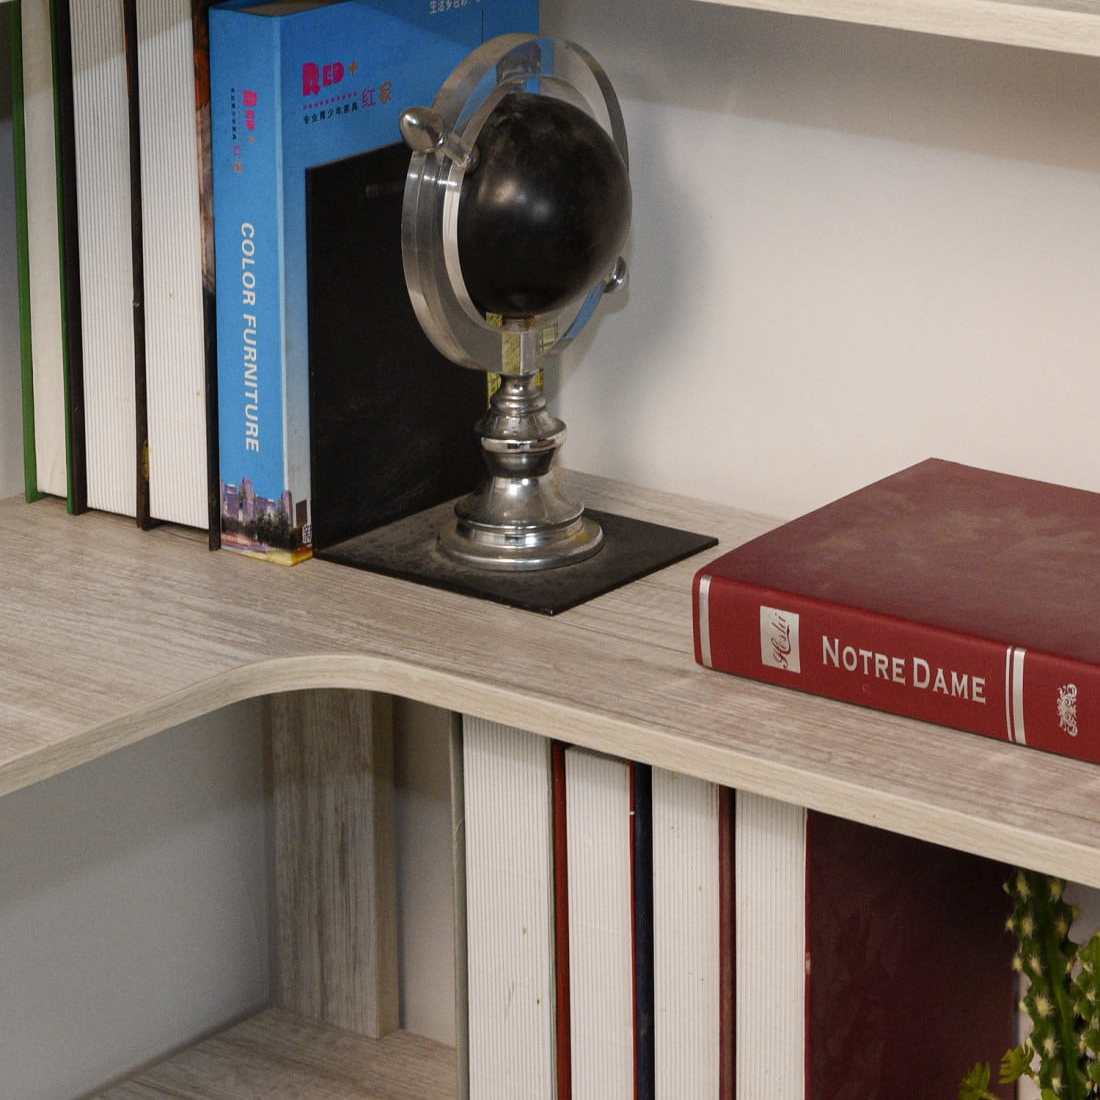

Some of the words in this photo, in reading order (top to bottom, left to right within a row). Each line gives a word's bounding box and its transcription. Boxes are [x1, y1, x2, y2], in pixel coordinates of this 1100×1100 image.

[240, 221, 256, 306] COLOR
[243, 313, 261, 453] FURNITURE
[821, 635, 905, 684] NOTRE
[913, 656, 986, 705] DAME
